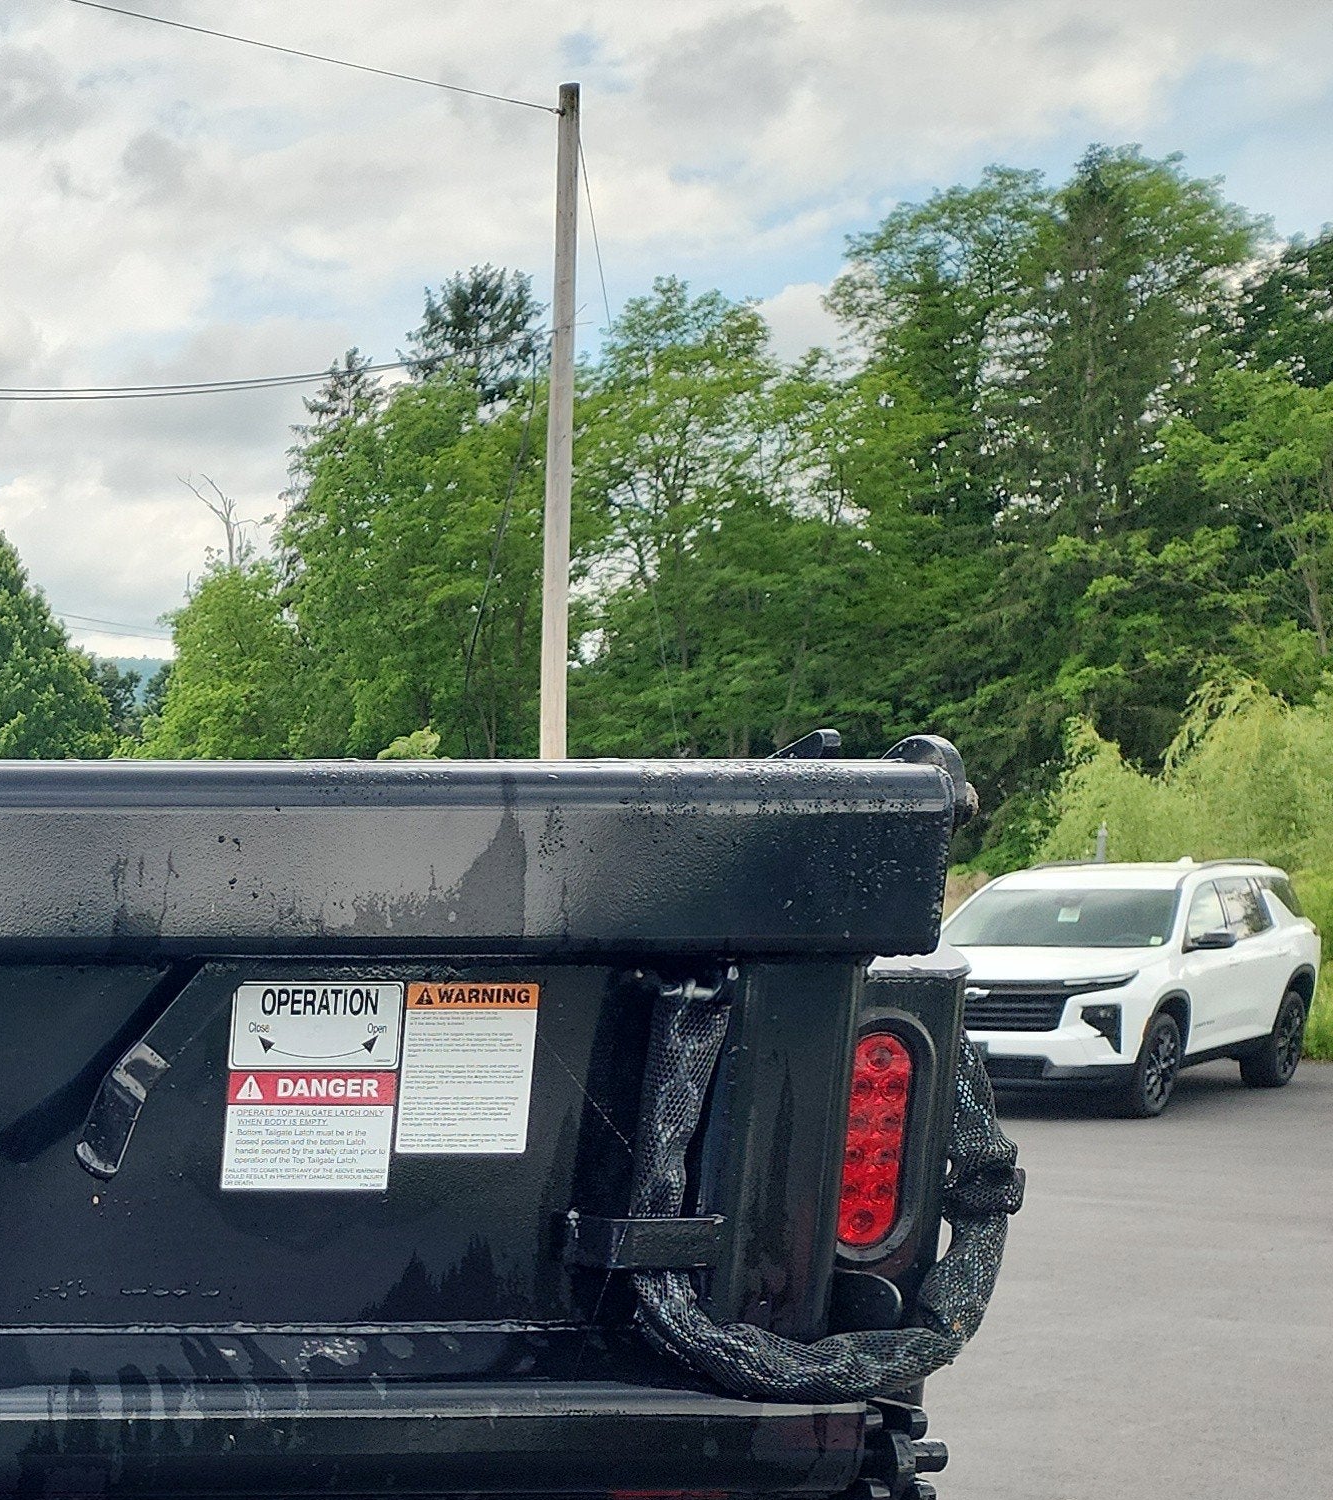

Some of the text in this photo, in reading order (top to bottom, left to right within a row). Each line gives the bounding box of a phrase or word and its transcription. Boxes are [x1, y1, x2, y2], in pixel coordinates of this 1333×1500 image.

[261, 988, 379, 1016] OPERATION
[437, 988, 531, 1004] WARNING
[248, 1022, 270, 1033] Close
[367, 1023, 387, 1035] Open
[277, 1078, 379, 1098] DANGER
[236, 1109, 274, 1117] OPERATE
[277, 1109, 293, 1117] TOP
[335, 1109, 361, 1117] LATCH
[363, 1109, 384, 1117] ONLY
